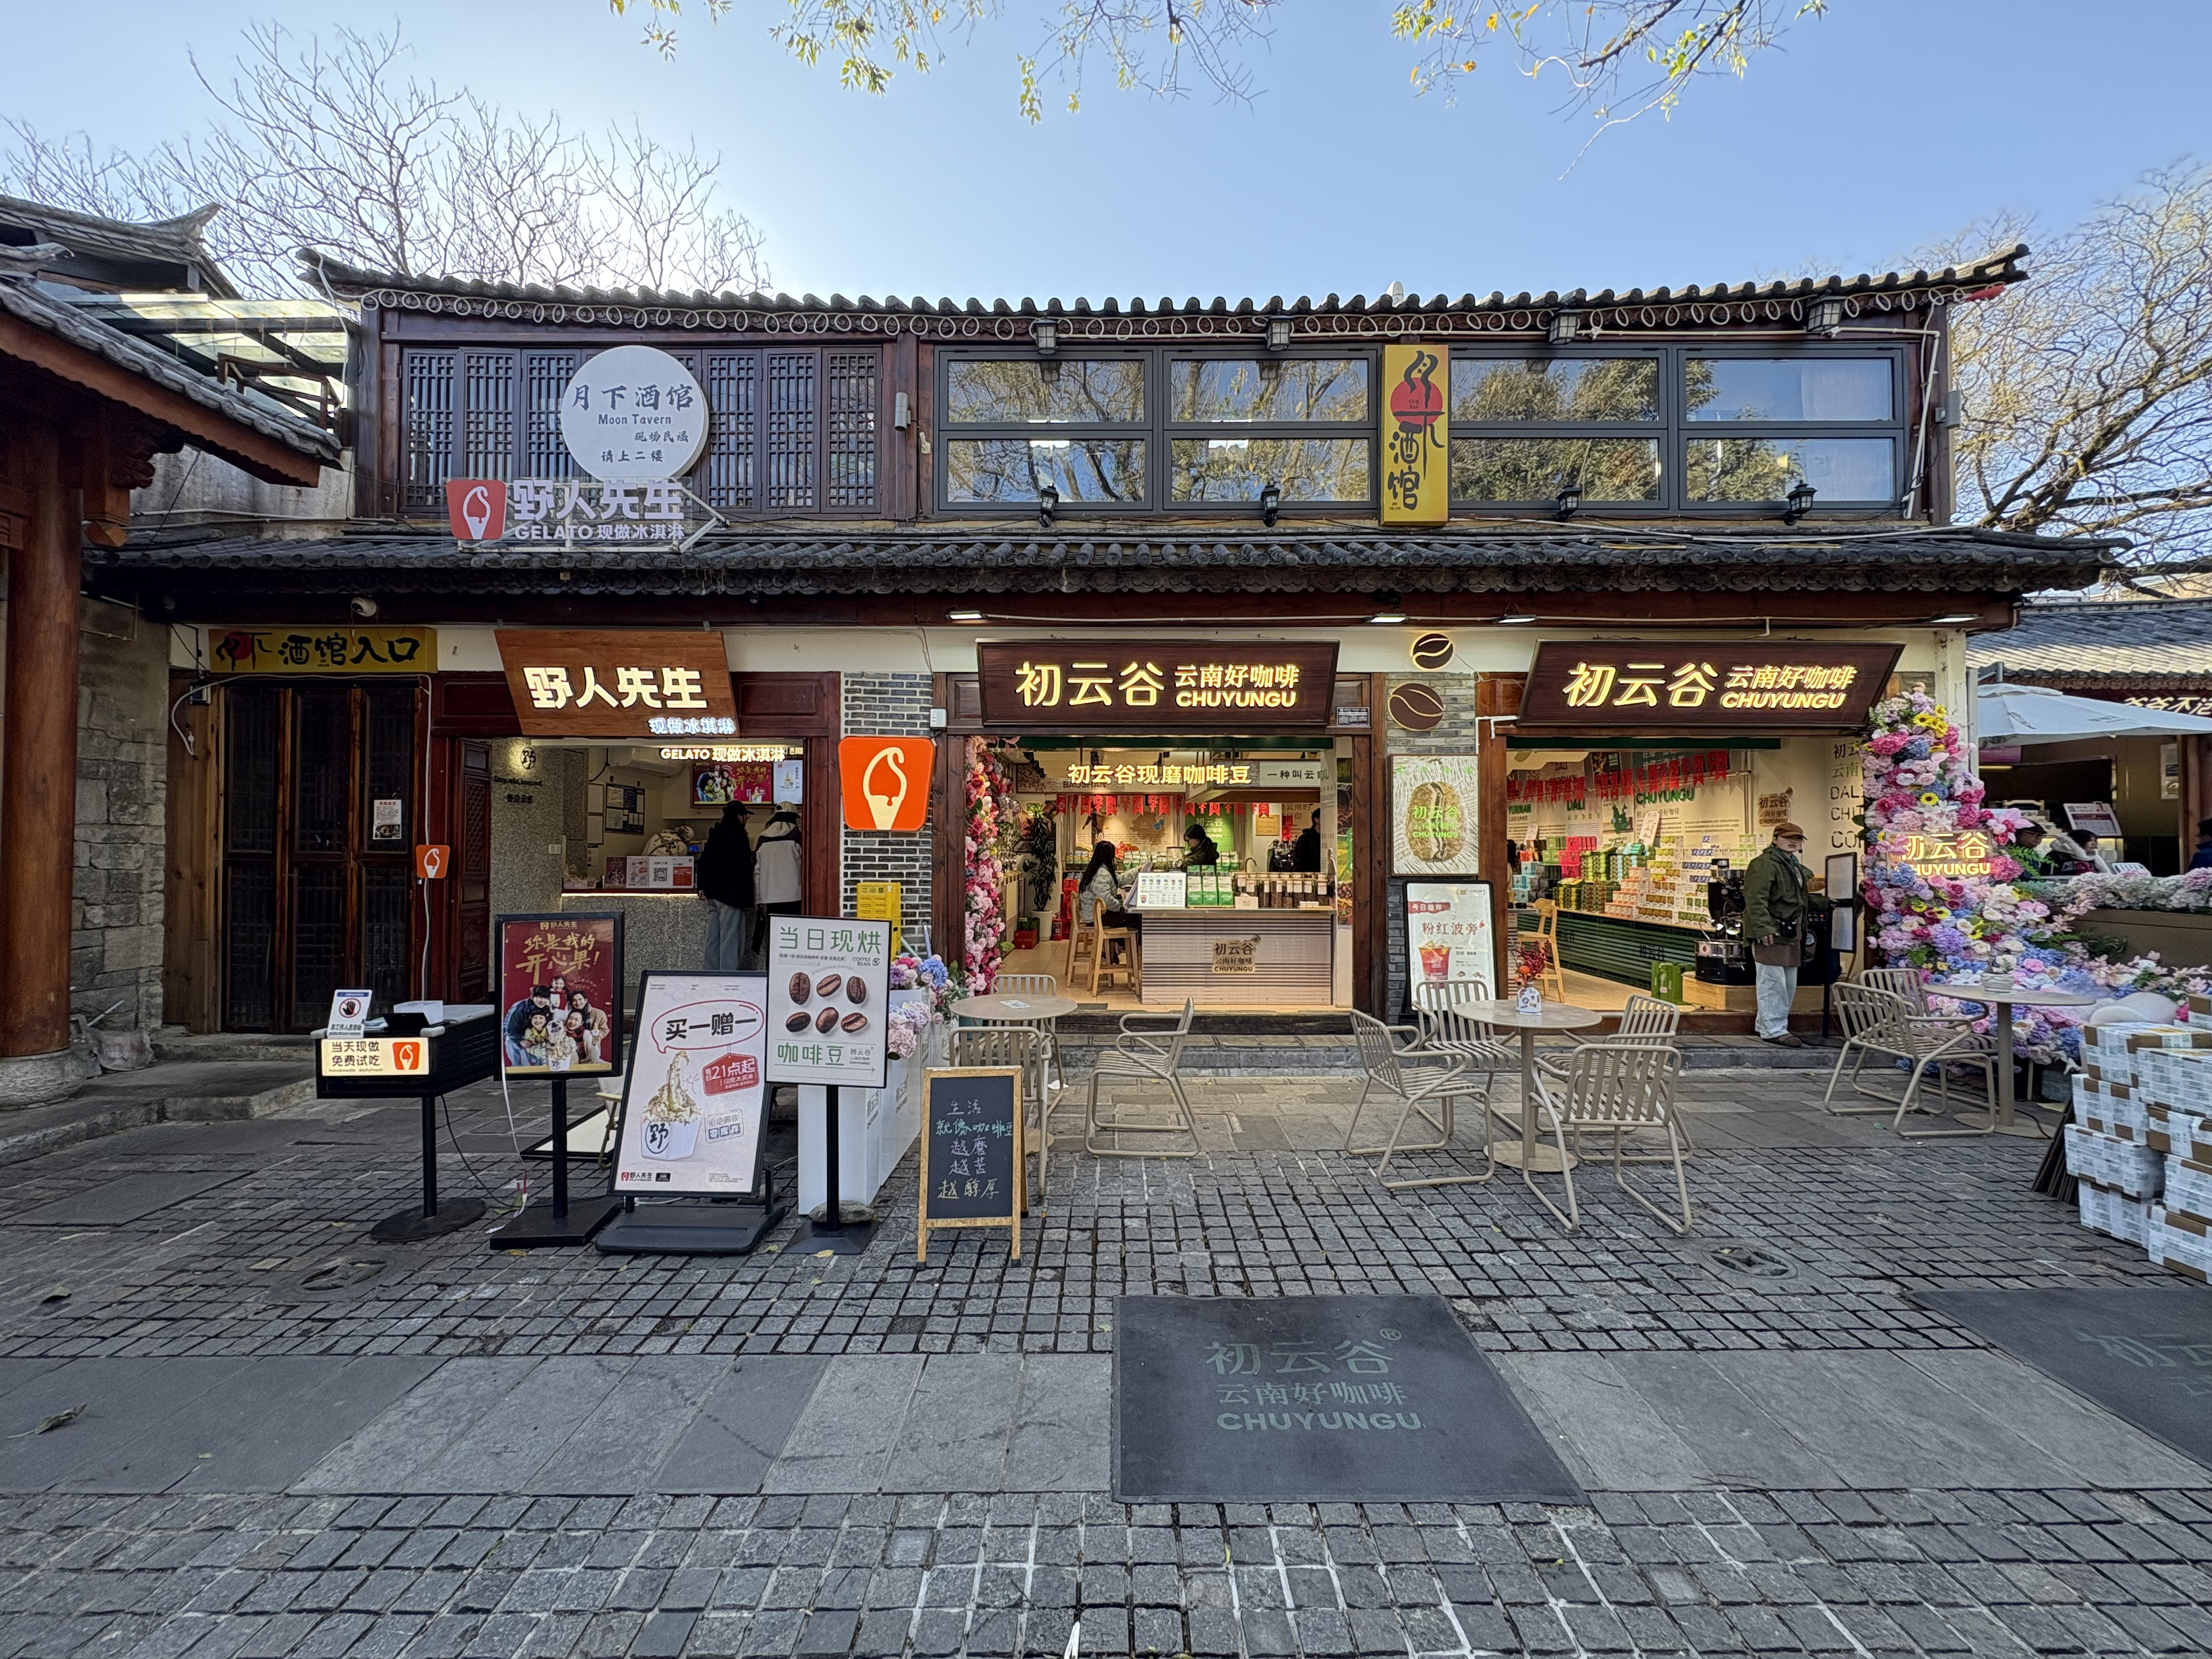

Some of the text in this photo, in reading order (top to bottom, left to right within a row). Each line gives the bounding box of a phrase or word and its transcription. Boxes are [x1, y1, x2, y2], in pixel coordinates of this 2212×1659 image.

[571, 384, 693, 411] 月下酒馆
[598, 414, 671, 425] Moon Tavern
[634, 431, 689, 443] 现场民谣
[601, 450, 664, 463] 请上二楼
[513, 479, 684, 520] 野人先生
[514, 524, 685, 540] GELATO 现做冰淇淋
[1014, 660, 1165, 708] 初云谷
[1174, 663, 1300, 689] 云南好咖啡
[1562, 661, 1719, 708] 初云谷
[1726, 665, 1859, 691] 云南好咖啡
[523, 666, 708, 709] 野人先生
[1175, 691, 1297, 708] CHUYUNGU
[1720, 692, 1847, 709] CHUYUNGU
[648, 717, 737, 735] 现做冰淇淋
[660, 748, 711, 760] GELATO
[711, 747, 786, 763] 现做冰淇淋
[1067, 763, 1252, 785] 初云谷现磨咖啡豆
[1636, 788, 1695, 805] CHUYUNGU
[1759, 795, 1788, 808] 初云谷
[1196, 817, 1224, 827] 初云谷
[1412, 805, 1459, 820] 初云谷
[1895, 862, 1991, 876] HUYUNGU
[1421, 921, 1478, 936] 粉红波旁
[523, 931, 596, 954] 你是我的
[779, 926, 881, 954] 当日现烘
[1214, 942, 1254, 955] 初云谷
[666, 1012, 757, 1042] 买一赠一
[331, 1041, 379, 1053] 当天现做
[778, 1042, 845, 1066] 咖啡豆
[332, 1055, 381, 1067] 免费试吃
[711, 1058, 756, 1079] 21点起
[946, 1099, 982, 1116] 生活
[935, 1118, 1013, 1139] 就像咖啡豆
[950, 1134, 988, 1156] 越磨
[948, 1157, 987, 1176] 越苦
[937, 1178, 1000, 1199] 越醇厚
[1204, 1339, 1395, 1376] 初云谷
[1216, 1381, 1408, 1405] 云南好咖啡
[1217, 1411, 1423, 1432] CHUYUNGU
